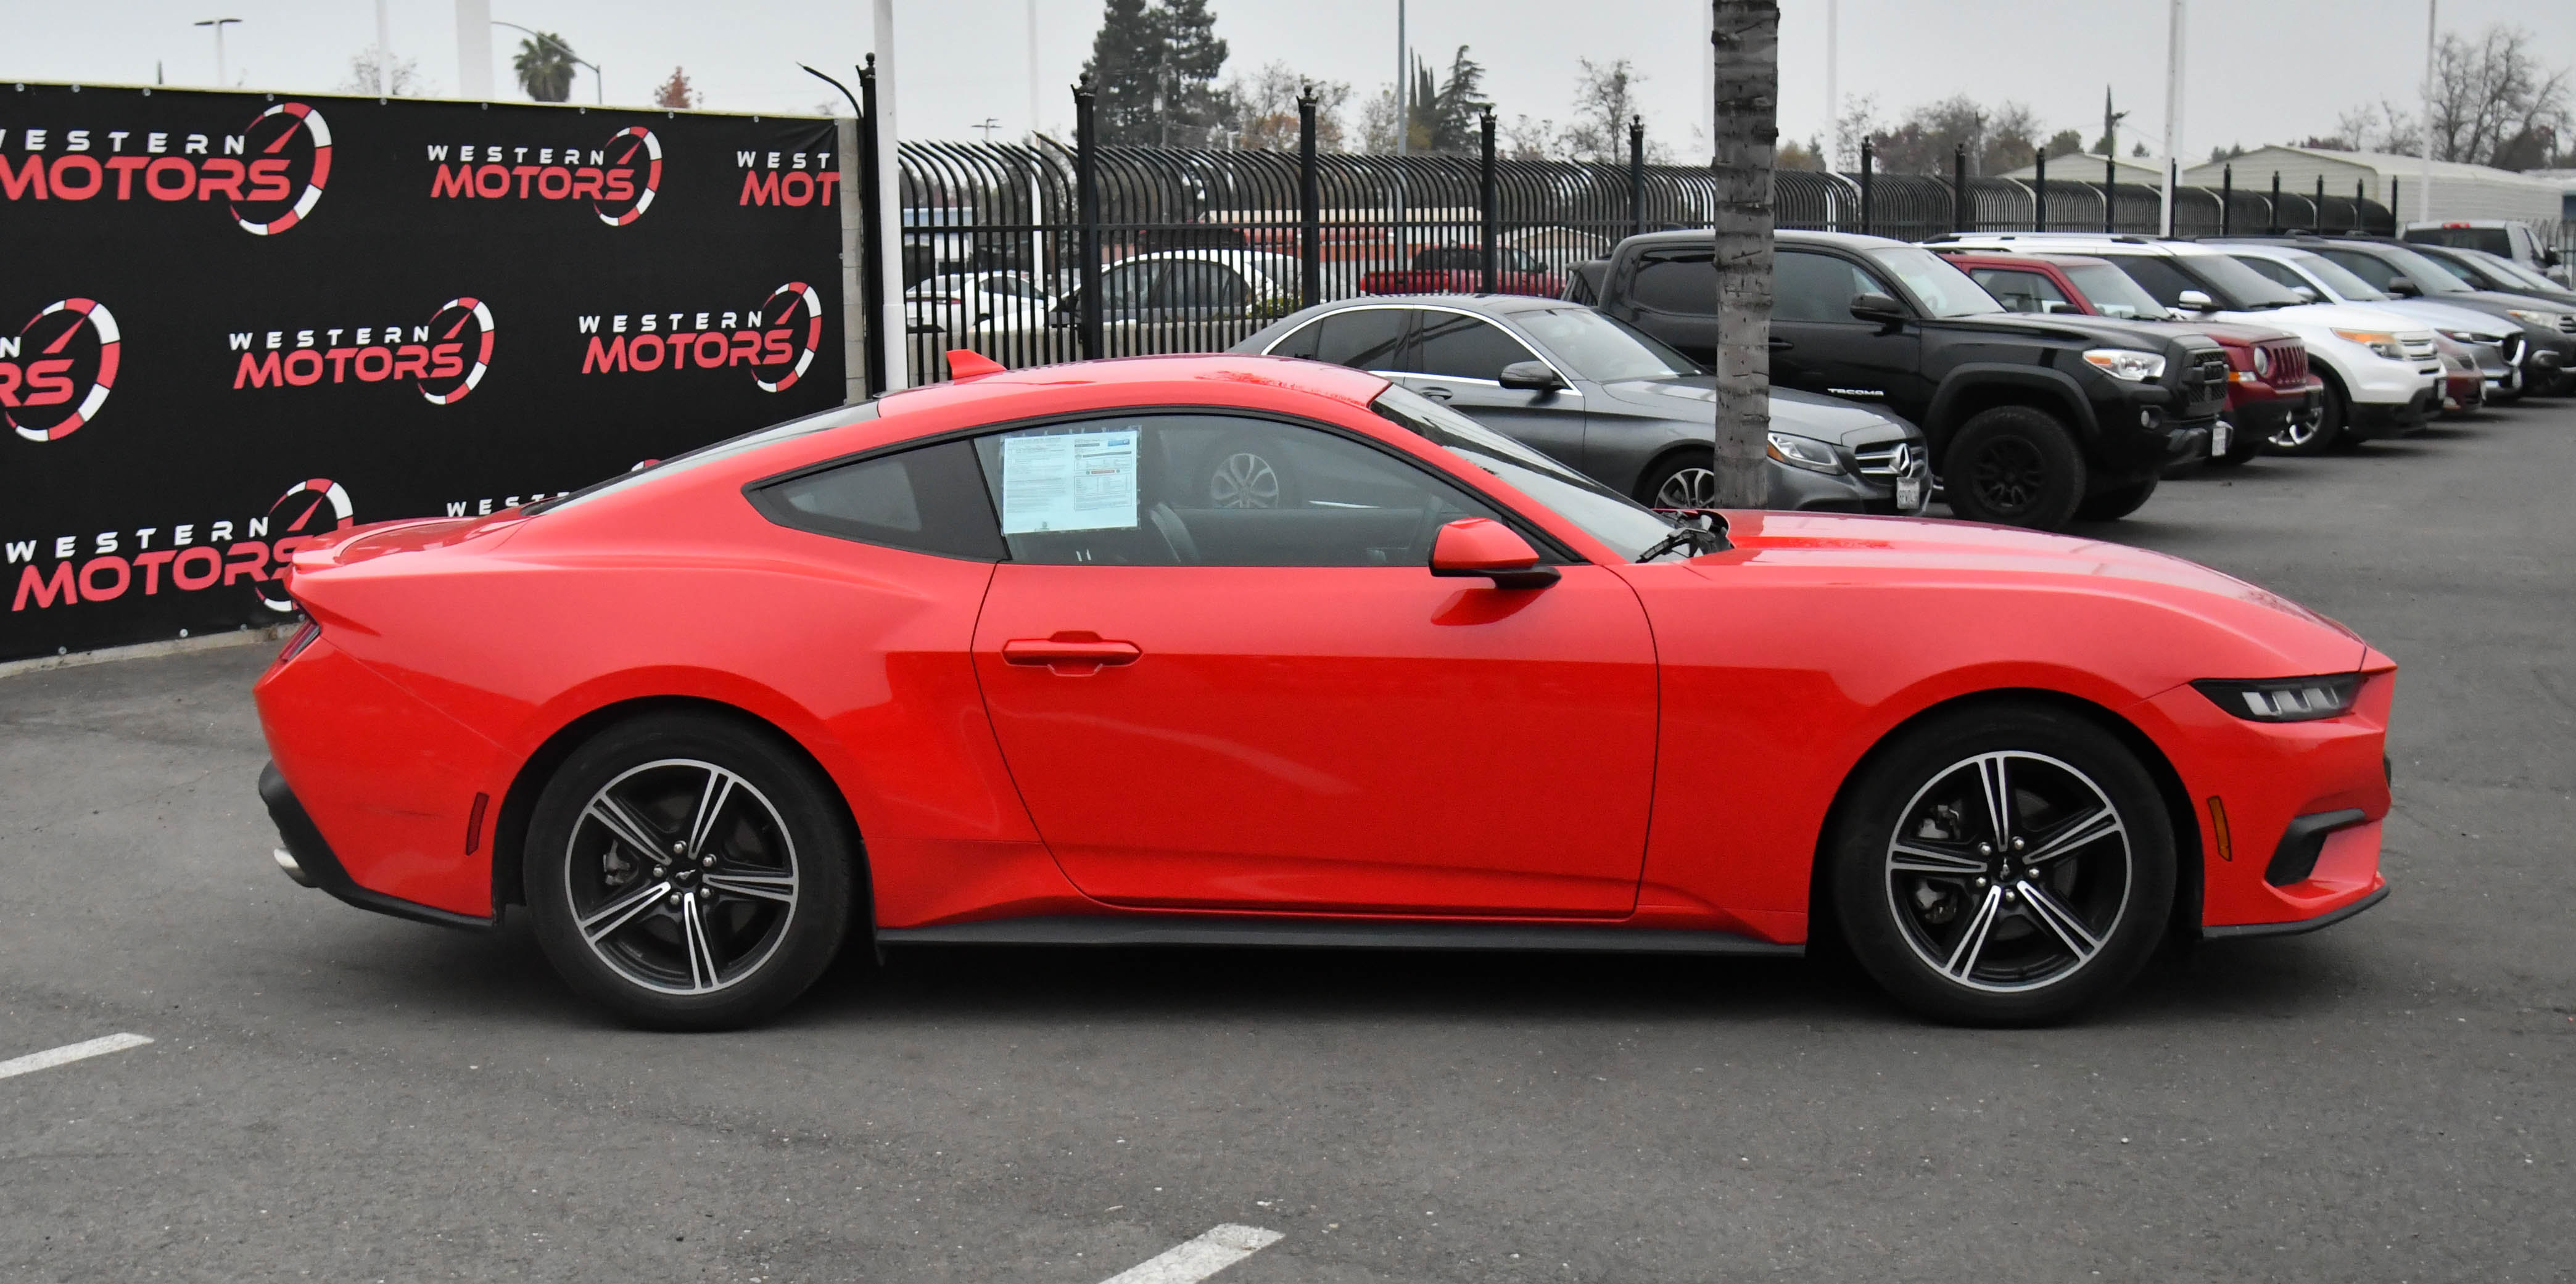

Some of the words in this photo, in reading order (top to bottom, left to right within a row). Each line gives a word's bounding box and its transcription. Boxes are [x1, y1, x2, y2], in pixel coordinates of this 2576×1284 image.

[427, 145, 605, 165] WESTERN
[737, 150, 831, 169] WEST
[0, 153, 291, 201] MOTORS
[431, 163, 635, 200] MOTORS
[739, 170, 840, 207] MOT
[229, 326, 429, 350] WESTERN
[579, 311, 762, 334] WESTERN
[233, 342, 463, 390] MOTORS
[581, 328, 793, 374] MOTORS
[1827, 388, 1885, 397] TACOMA
[6, 516, 269, 564] WESTERN
